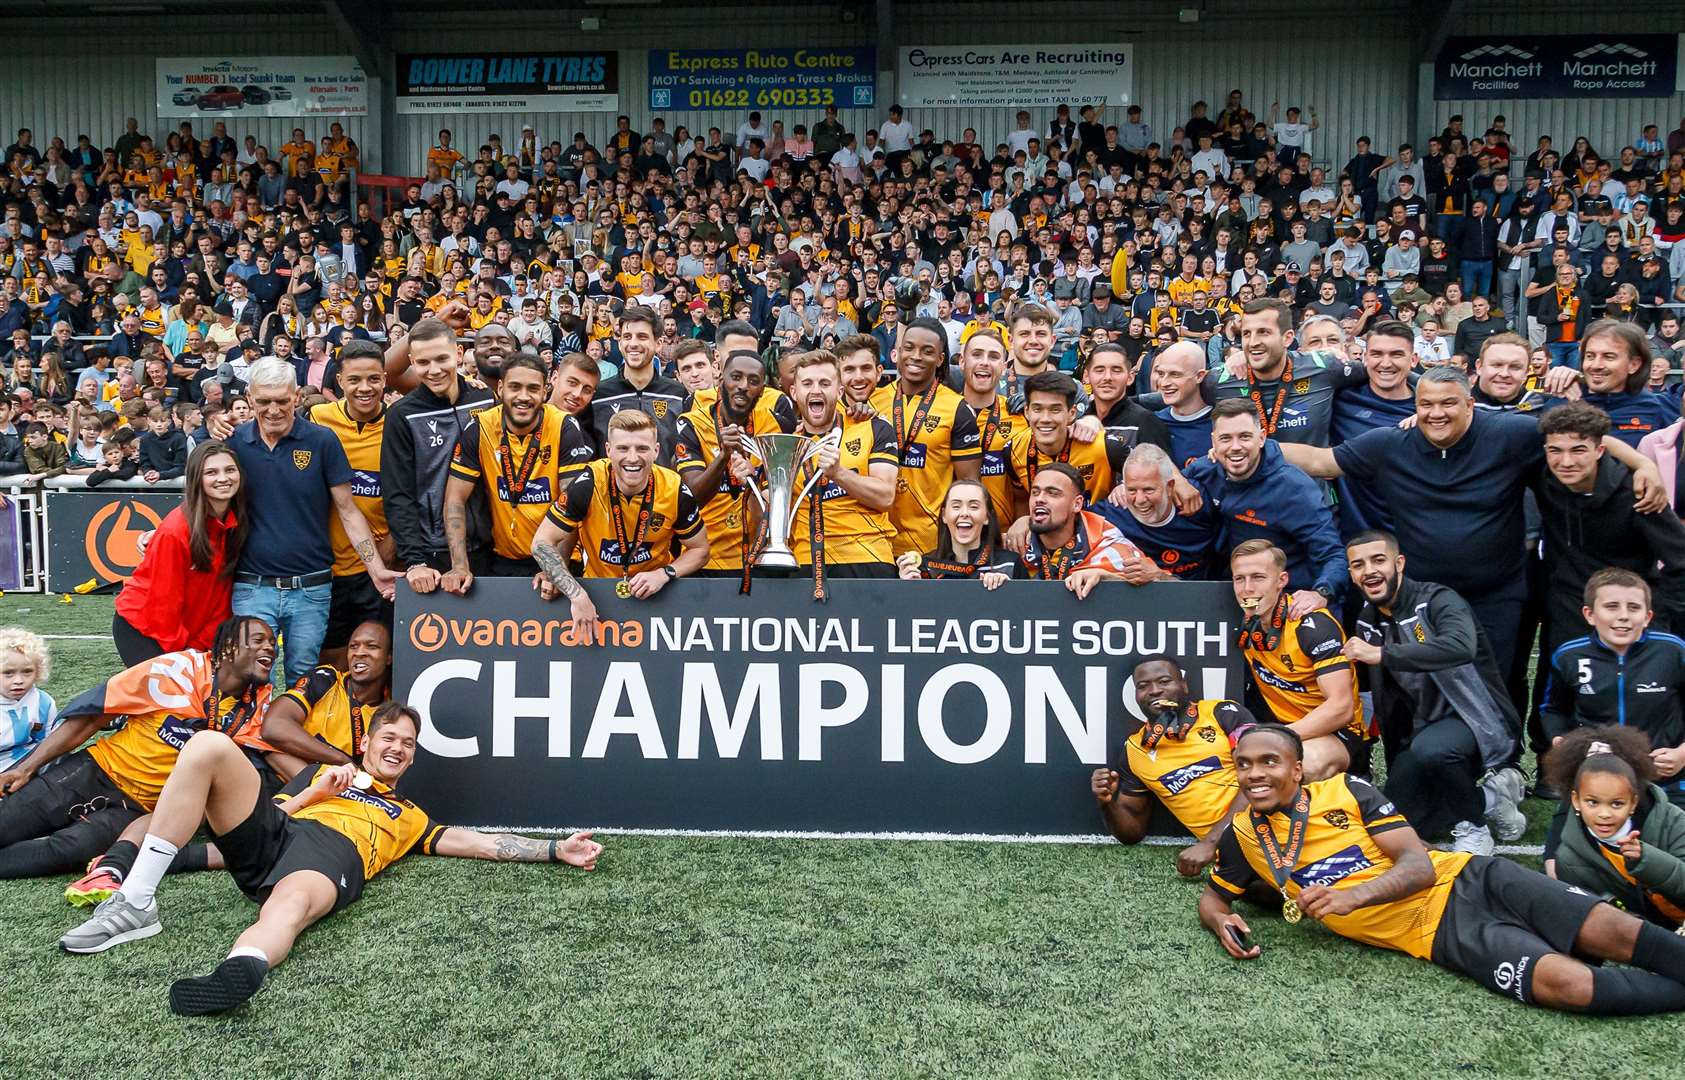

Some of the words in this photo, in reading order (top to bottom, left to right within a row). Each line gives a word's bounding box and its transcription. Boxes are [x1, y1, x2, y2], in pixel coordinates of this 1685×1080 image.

[668, 51, 740, 73] Express
[744, 51, 789, 69] Auto
[794, 49, 856, 69] Centre
[964, 51, 996, 66] Cars
[1000, 51, 1030, 65] Are
[1036, 49, 1126, 66] Recruiting
[408, 58, 485, 84] BOWER
[487, 57, 538, 83] LANE
[542, 56, 607, 82] TYRES
[1449, 61, 1543, 78] Manchett
[1562, 60, 1657, 77] Manchett
[167, 74, 184, 84] Your
[185, 74, 220, 84] NUMBER
[228, 73, 248, 83] local
[248, 73, 273, 83] Suzuki
[275, 73, 296, 84] team
[652, 76, 680, 86] MOT
[689, 75, 736, 87] Servicing
[746, 74, 787, 87] Repairs
[797, 73, 826, 86] Tyres
[835, 73, 872, 83] Brakes
[1472, 80, 1520, 90] Facilities
[1572, 79, 1604, 90] Rope
[1605, 78, 1646, 88] Access
[689, 89, 750, 107] 01622
[756, 88, 834, 107] 690333
[959, 97, 1005, 105] information
[1007, 97, 1033, 105] please
[1277, 416, 1309, 429] chett
[430, 436, 444, 447] 26
[650, 616, 875, 653] NATIONAL
[887, 618, 1060, 655] LEAGUE
[1072, 619, 1228, 657] SOUTH
[1578, 658, 1593, 684] 5
